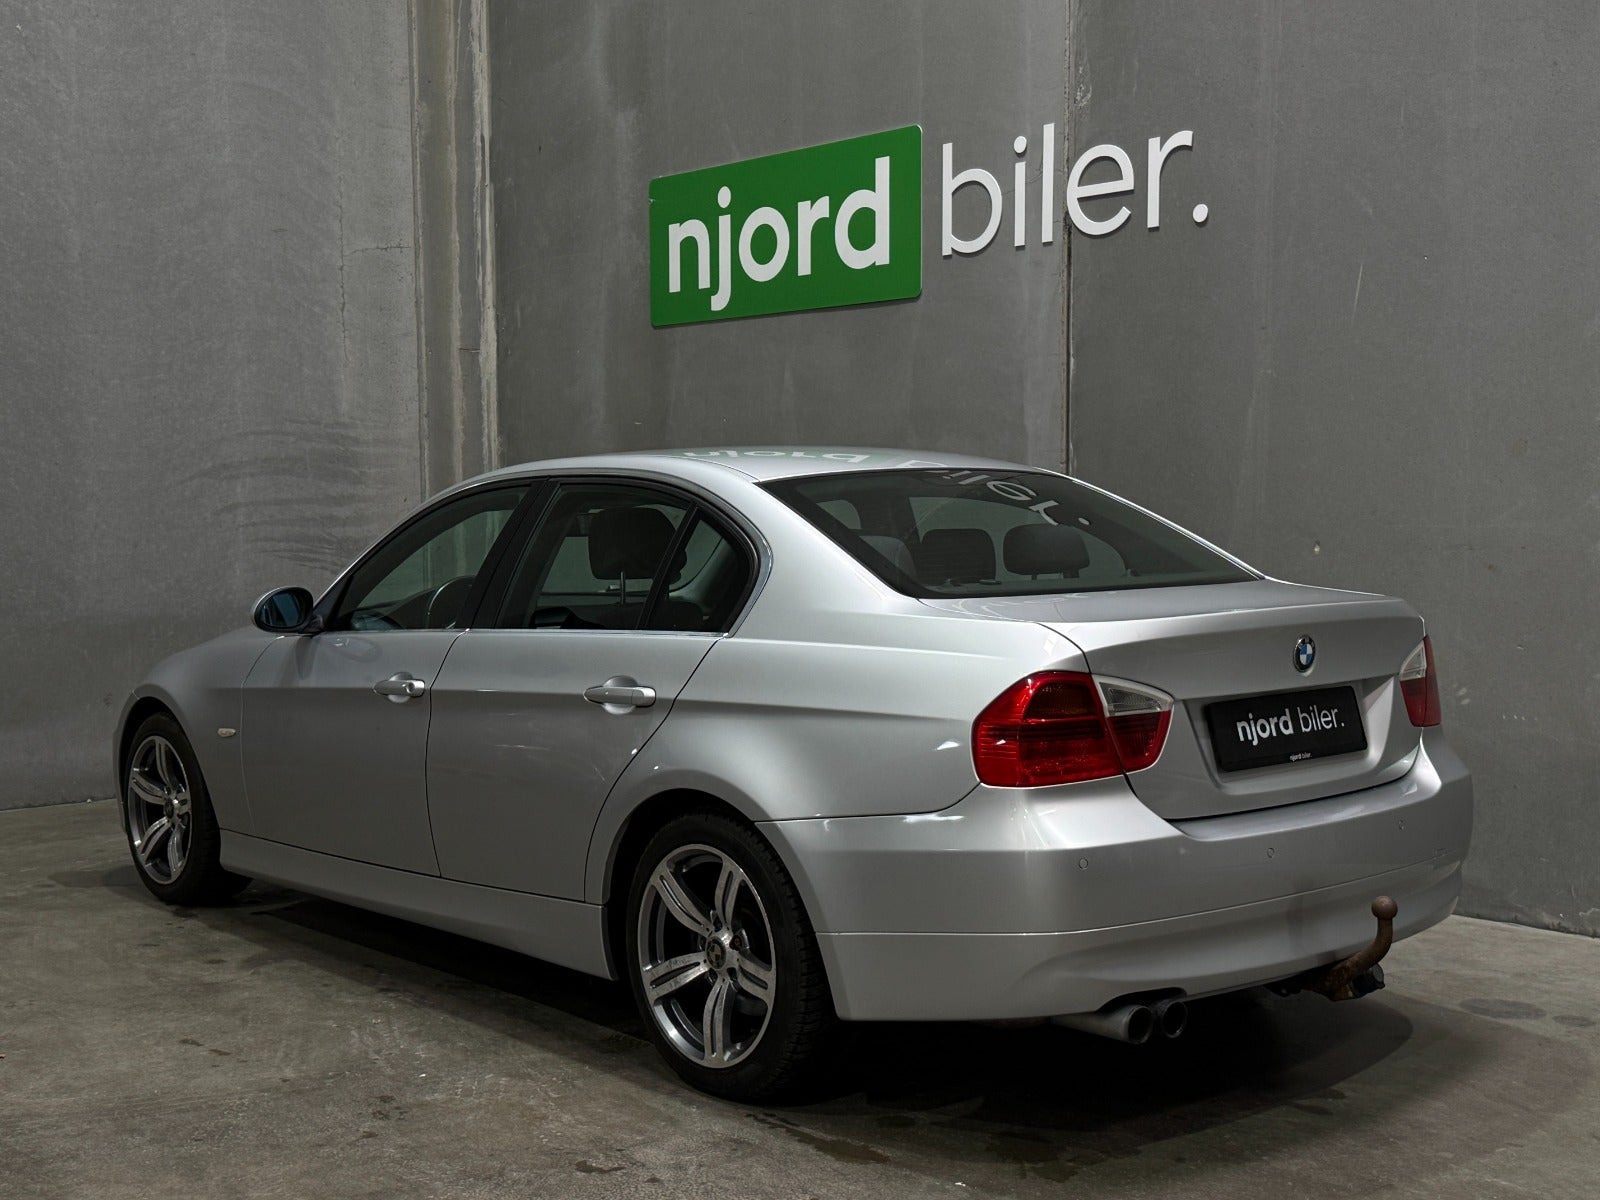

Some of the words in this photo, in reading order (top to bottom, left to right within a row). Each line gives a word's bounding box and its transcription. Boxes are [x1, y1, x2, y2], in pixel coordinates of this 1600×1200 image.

[668, 155, 890, 311] njord
[941, 122, 1209, 257] biler.
[1236, 708, 1294, 746] njord
[1297, 704, 1345, 733] biler.
